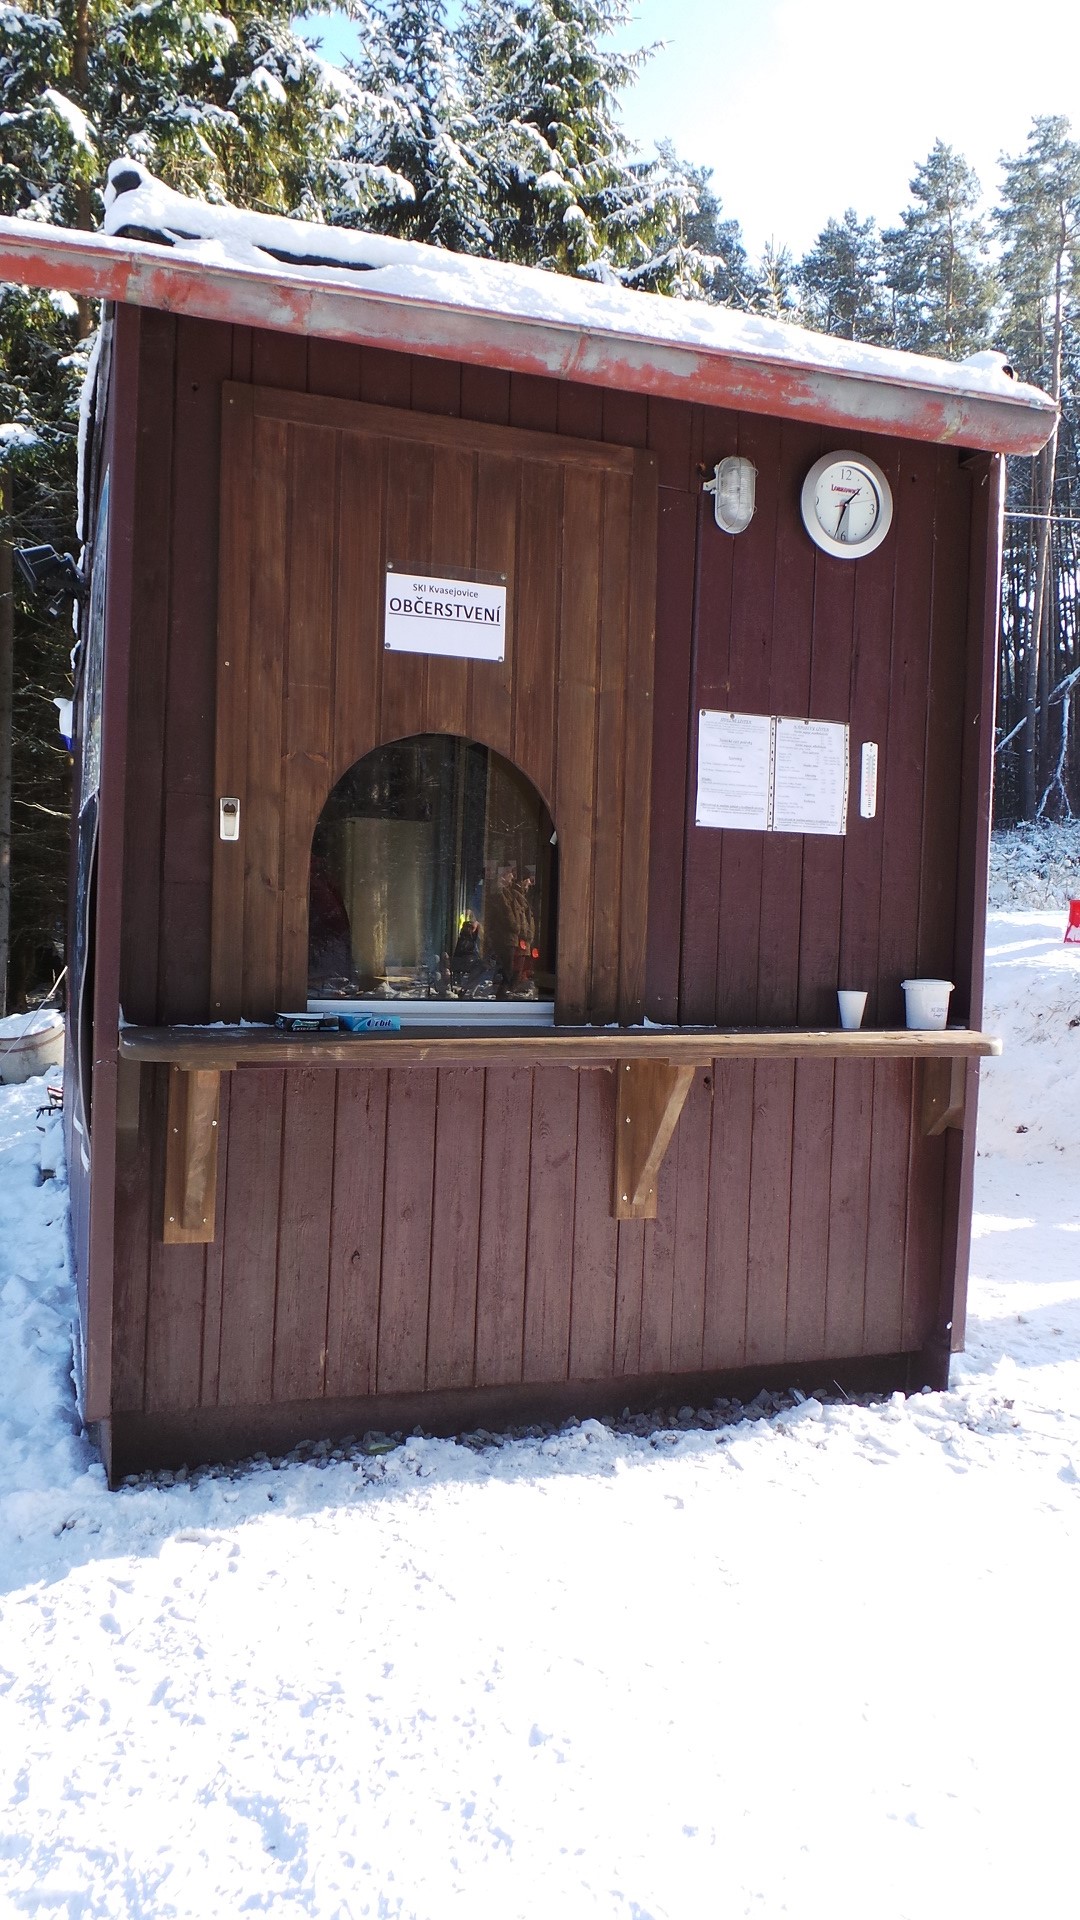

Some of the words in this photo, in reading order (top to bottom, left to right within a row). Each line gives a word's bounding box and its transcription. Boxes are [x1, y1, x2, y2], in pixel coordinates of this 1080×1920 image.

[841, 469, 852, 481] 12
[869, 503, 875, 515] 3
[840, 530, 846, 541] 6
[412, 583, 427, 592] SKI
[429, 585, 479, 598] Kvasejovice
[389, 596, 501, 623] OBČERSTVENÍ
